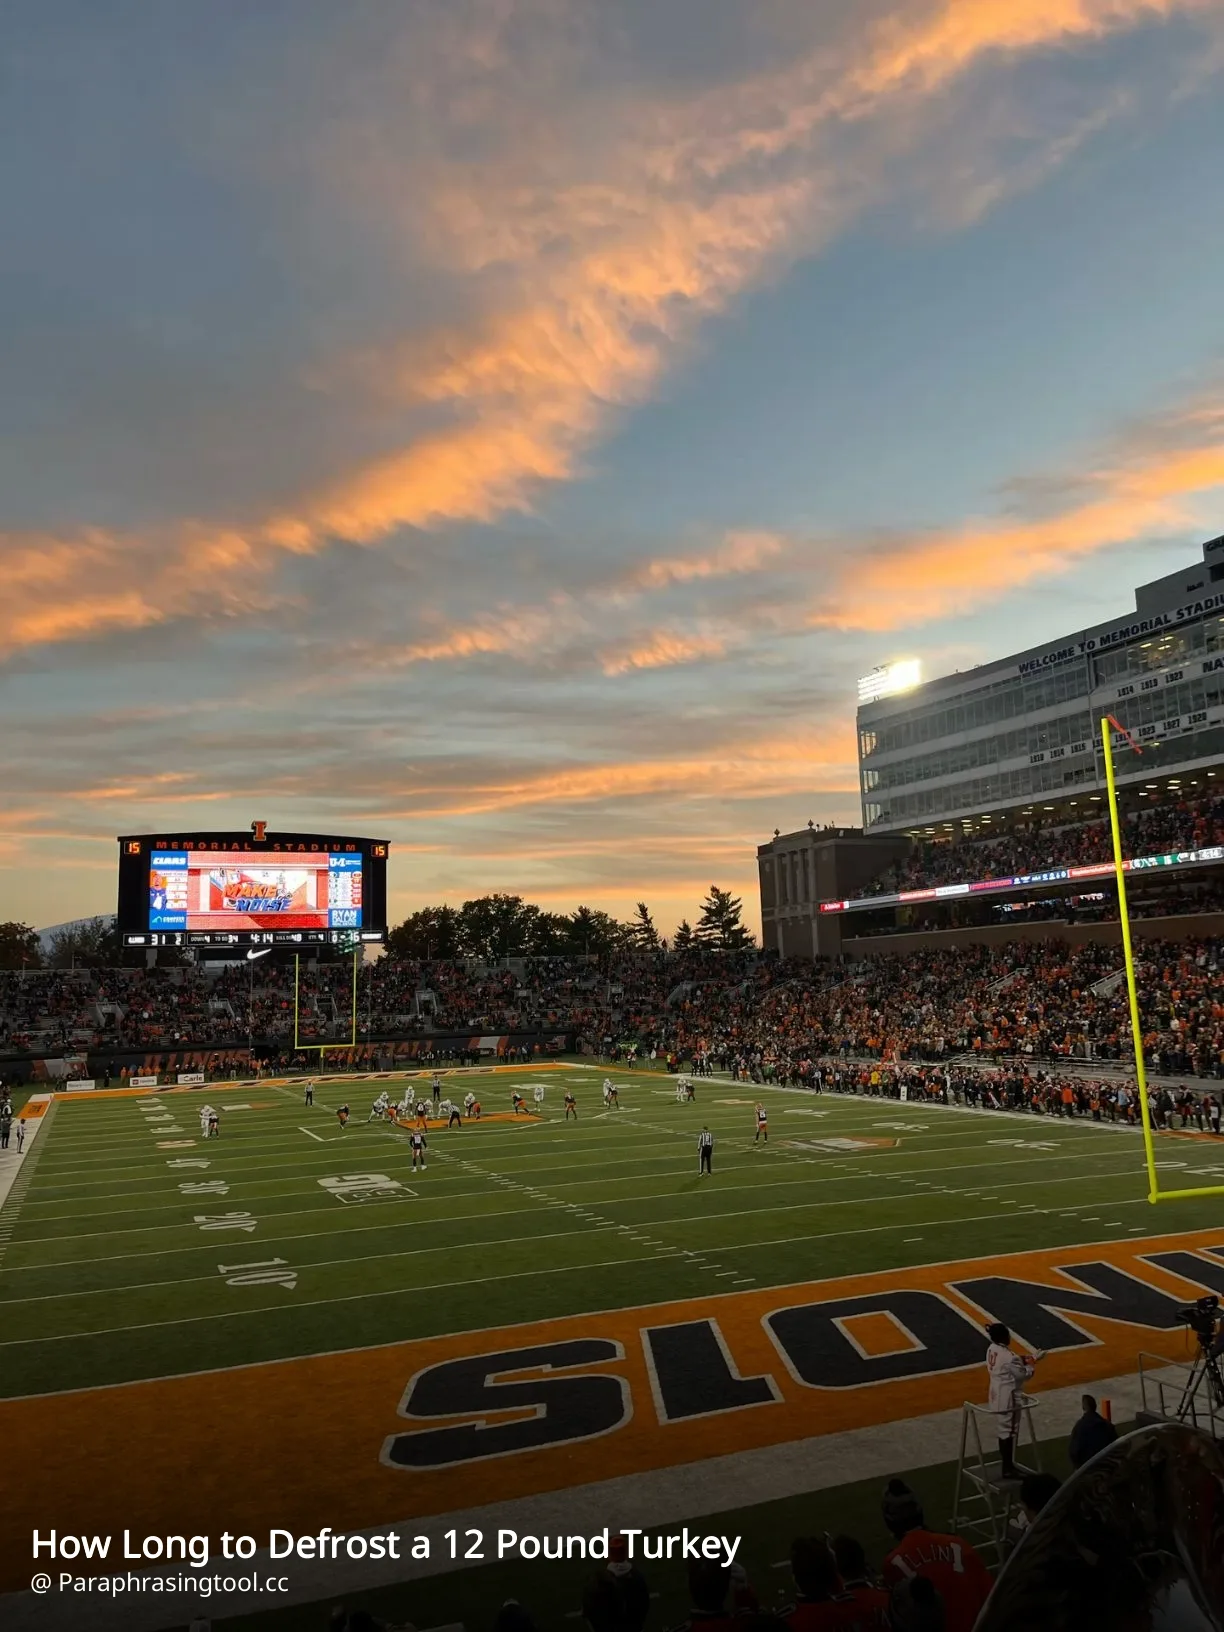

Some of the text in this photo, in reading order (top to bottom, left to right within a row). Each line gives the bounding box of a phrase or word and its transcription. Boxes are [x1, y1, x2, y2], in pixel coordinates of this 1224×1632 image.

[1018, 646, 1075, 674] WELCOME
[1077, 640, 1096, 652] TO
[1100, 614, 1171, 646] MEMORIAL
[128, 843, 140, 854] 15
[156, 841, 357, 852] MEMORIAL STADIUM
[374, 846, 385, 856] 15
[222, 883, 277, 898] MAKE
[236, 897, 292, 911] NOISE
[250, 933, 274, 943] 4:14
[890, 1541, 965, 1579] ILLINI
